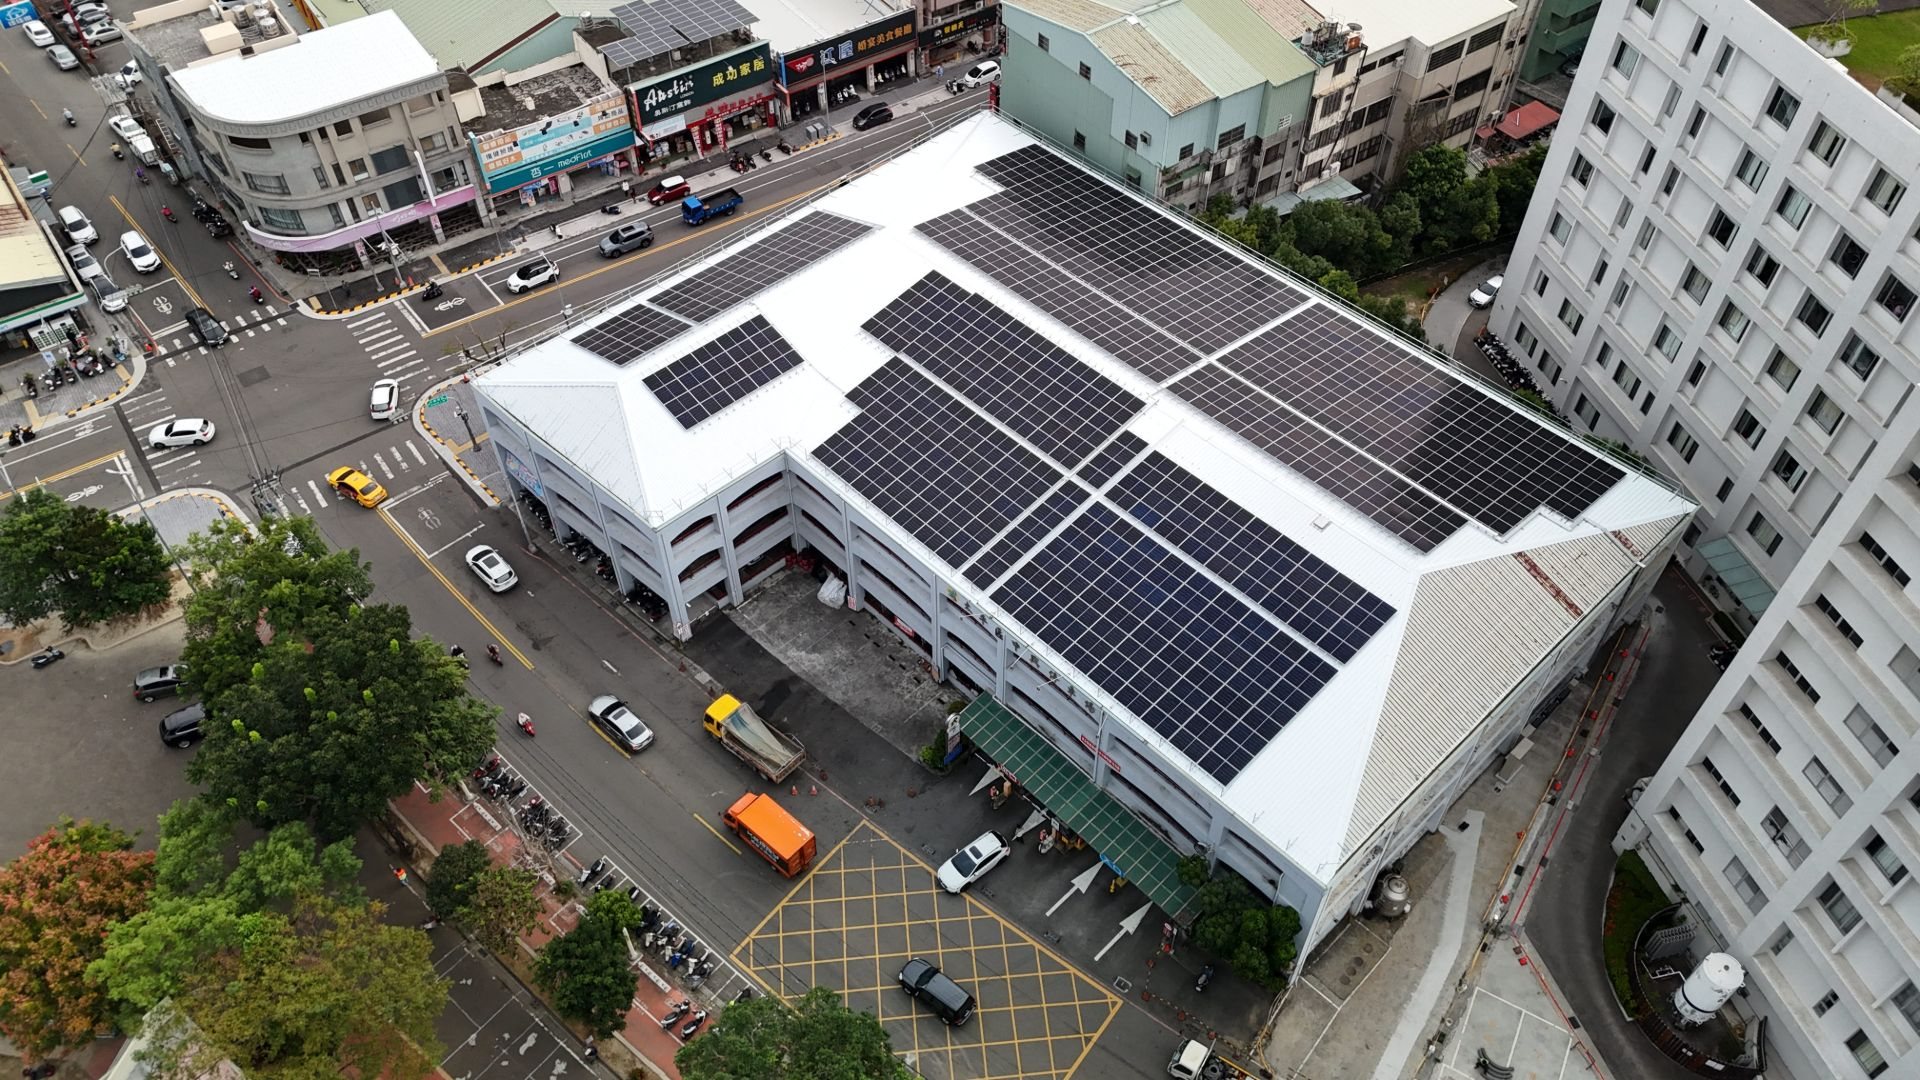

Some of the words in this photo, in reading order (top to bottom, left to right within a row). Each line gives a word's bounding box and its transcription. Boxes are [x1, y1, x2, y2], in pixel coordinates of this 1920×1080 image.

[712, 58, 765, 87] 成功家居
[643, 79, 694, 111] Austin
